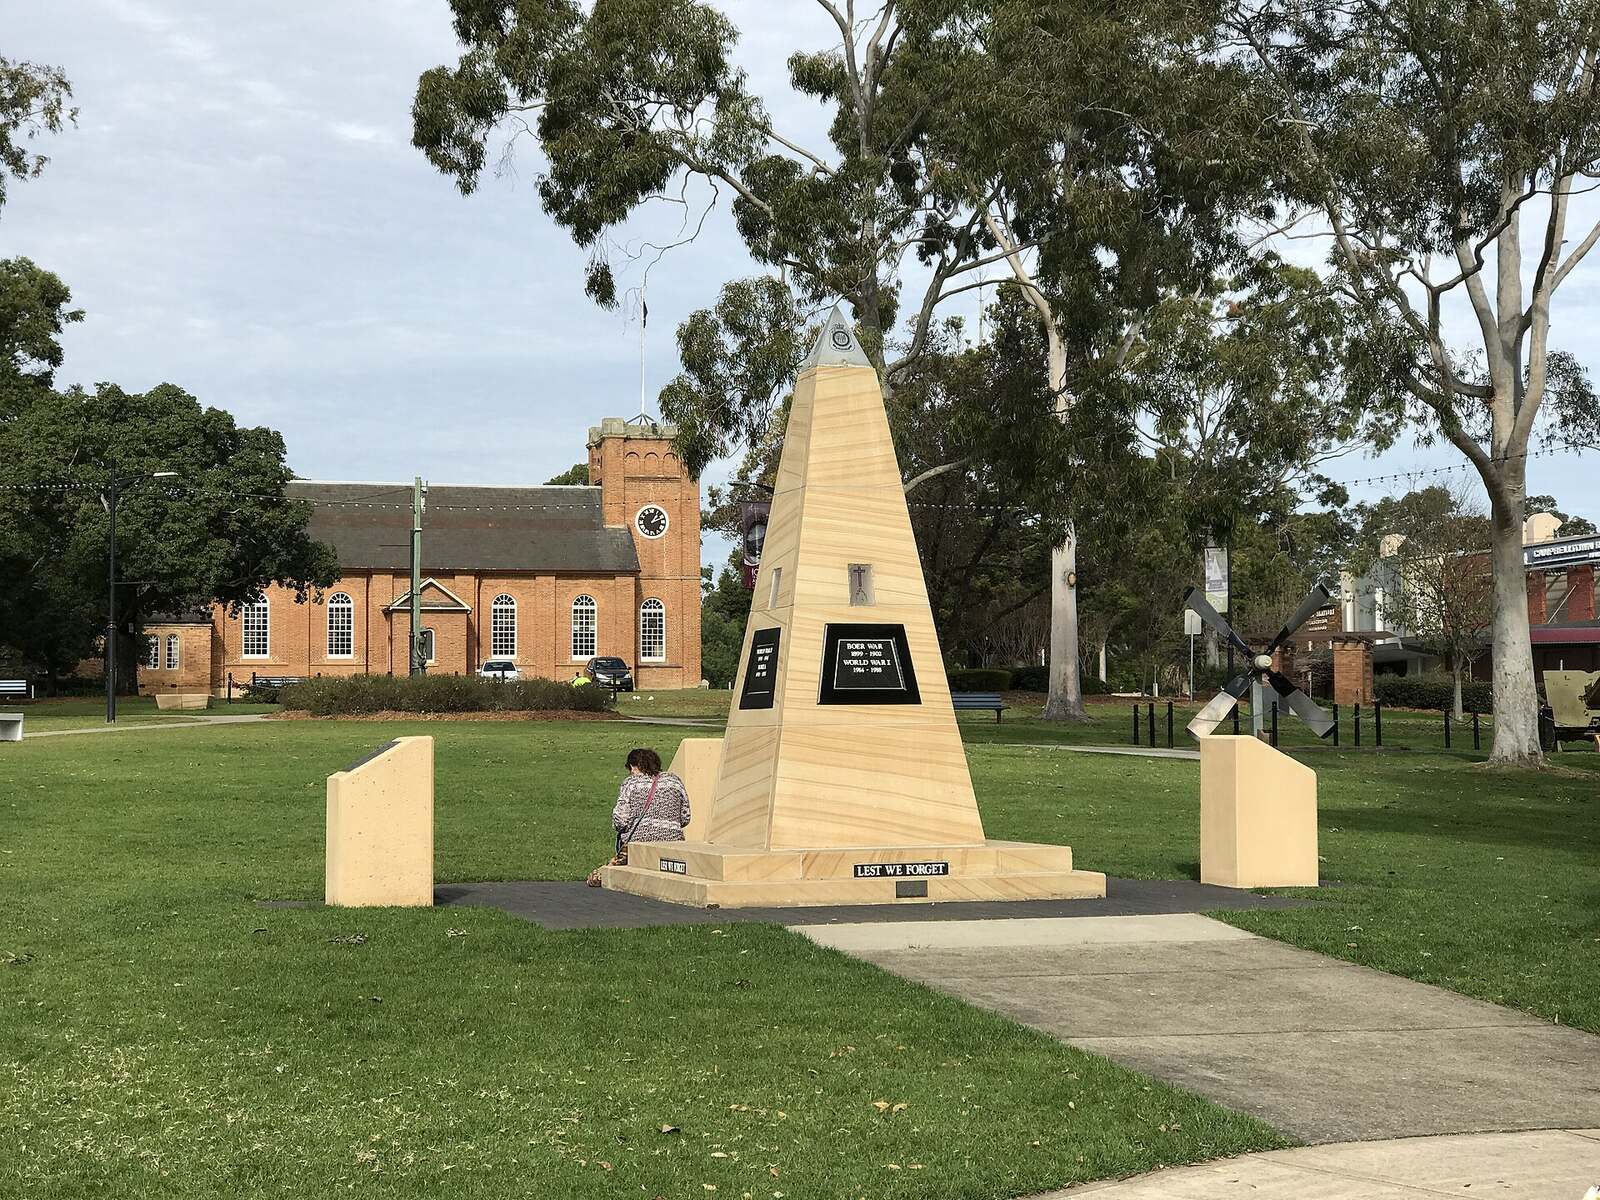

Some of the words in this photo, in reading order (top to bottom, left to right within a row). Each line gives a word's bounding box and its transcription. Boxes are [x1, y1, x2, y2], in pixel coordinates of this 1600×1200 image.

[857, 865, 882, 876] LEST
[885, 865, 903, 875] WE
[905, 864, 945, 875] FORGET
